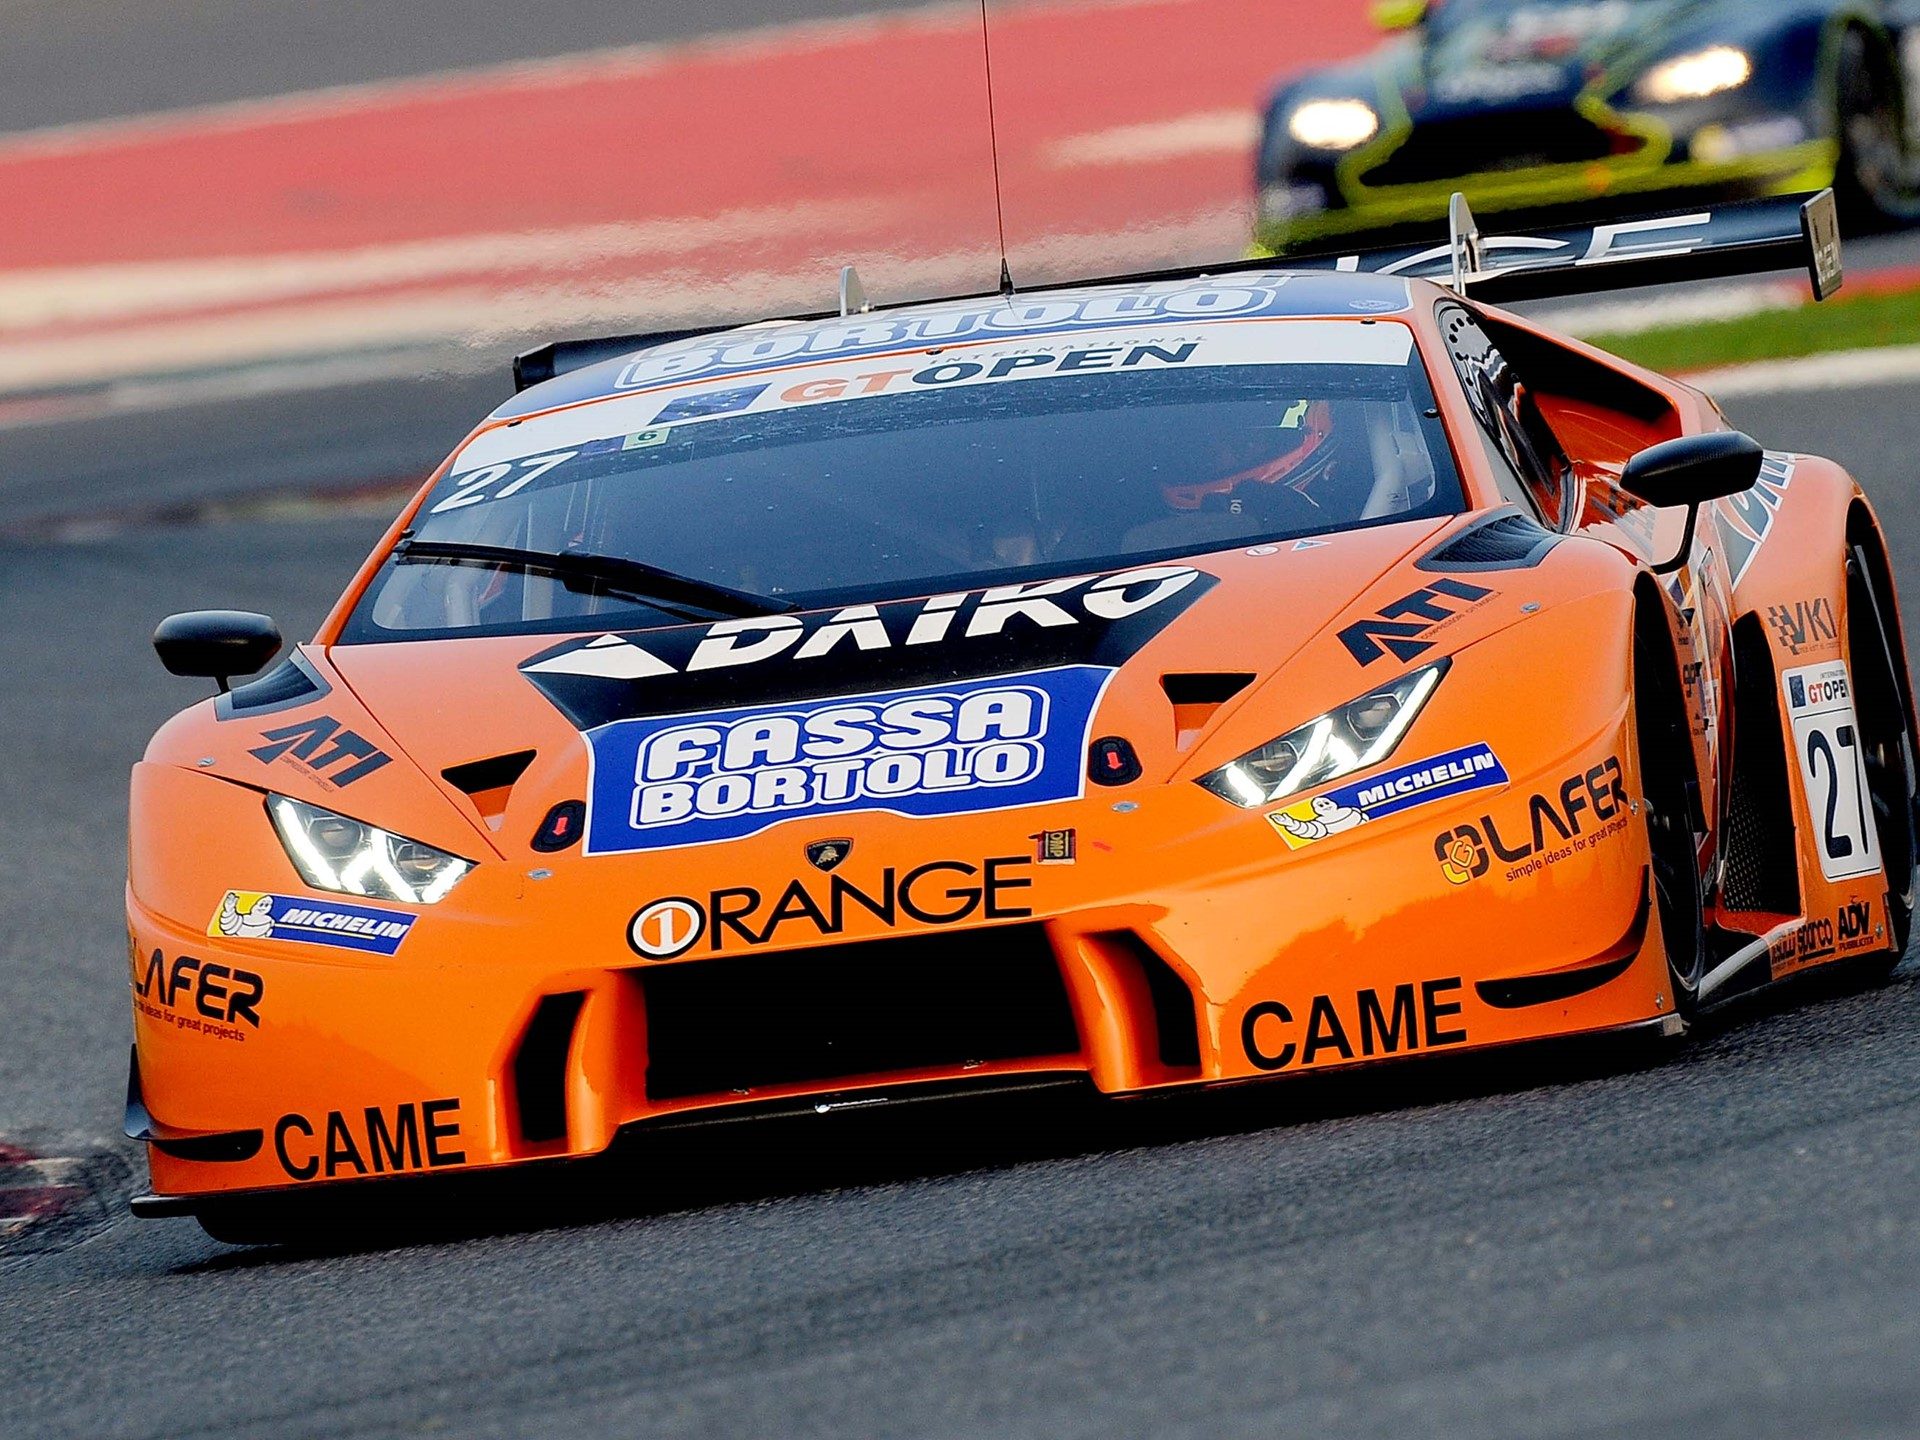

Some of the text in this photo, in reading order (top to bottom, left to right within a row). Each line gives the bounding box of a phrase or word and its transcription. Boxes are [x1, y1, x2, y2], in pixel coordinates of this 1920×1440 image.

[930, 335, 1208, 365] INTERNATIONAL
[637, 430, 658, 442] 6
[430, 451, 578, 514] 27
[686, 565, 1200, 672] DAIKO
[1335, 577, 1494, 668] ATI
[1768, 598, 1838, 655] VKI
[247, 715, 394, 788] ATI
[645, 689, 1034, 781] FASSA
[637, 742, 1033, 825] BORTOLO
[1357, 752, 1496, 806] MICHELIN
[1806, 724, 1869, 859] 27
[1049, 831, 1064, 857] OMP
[1506, 859, 1542, 882] simple
[1543, 848, 1573, 866] ideas
[1573, 837, 1588, 852] for
[280, 908, 410, 939] MICHELIN
[1838, 901, 1871, 940] ADV
[177, 1015, 202, 1029] great
[203, 1023, 245, 1042] projects
[1240, 976, 1468, 1071] CAME
[274, 1097, 467, 1181] CAME
